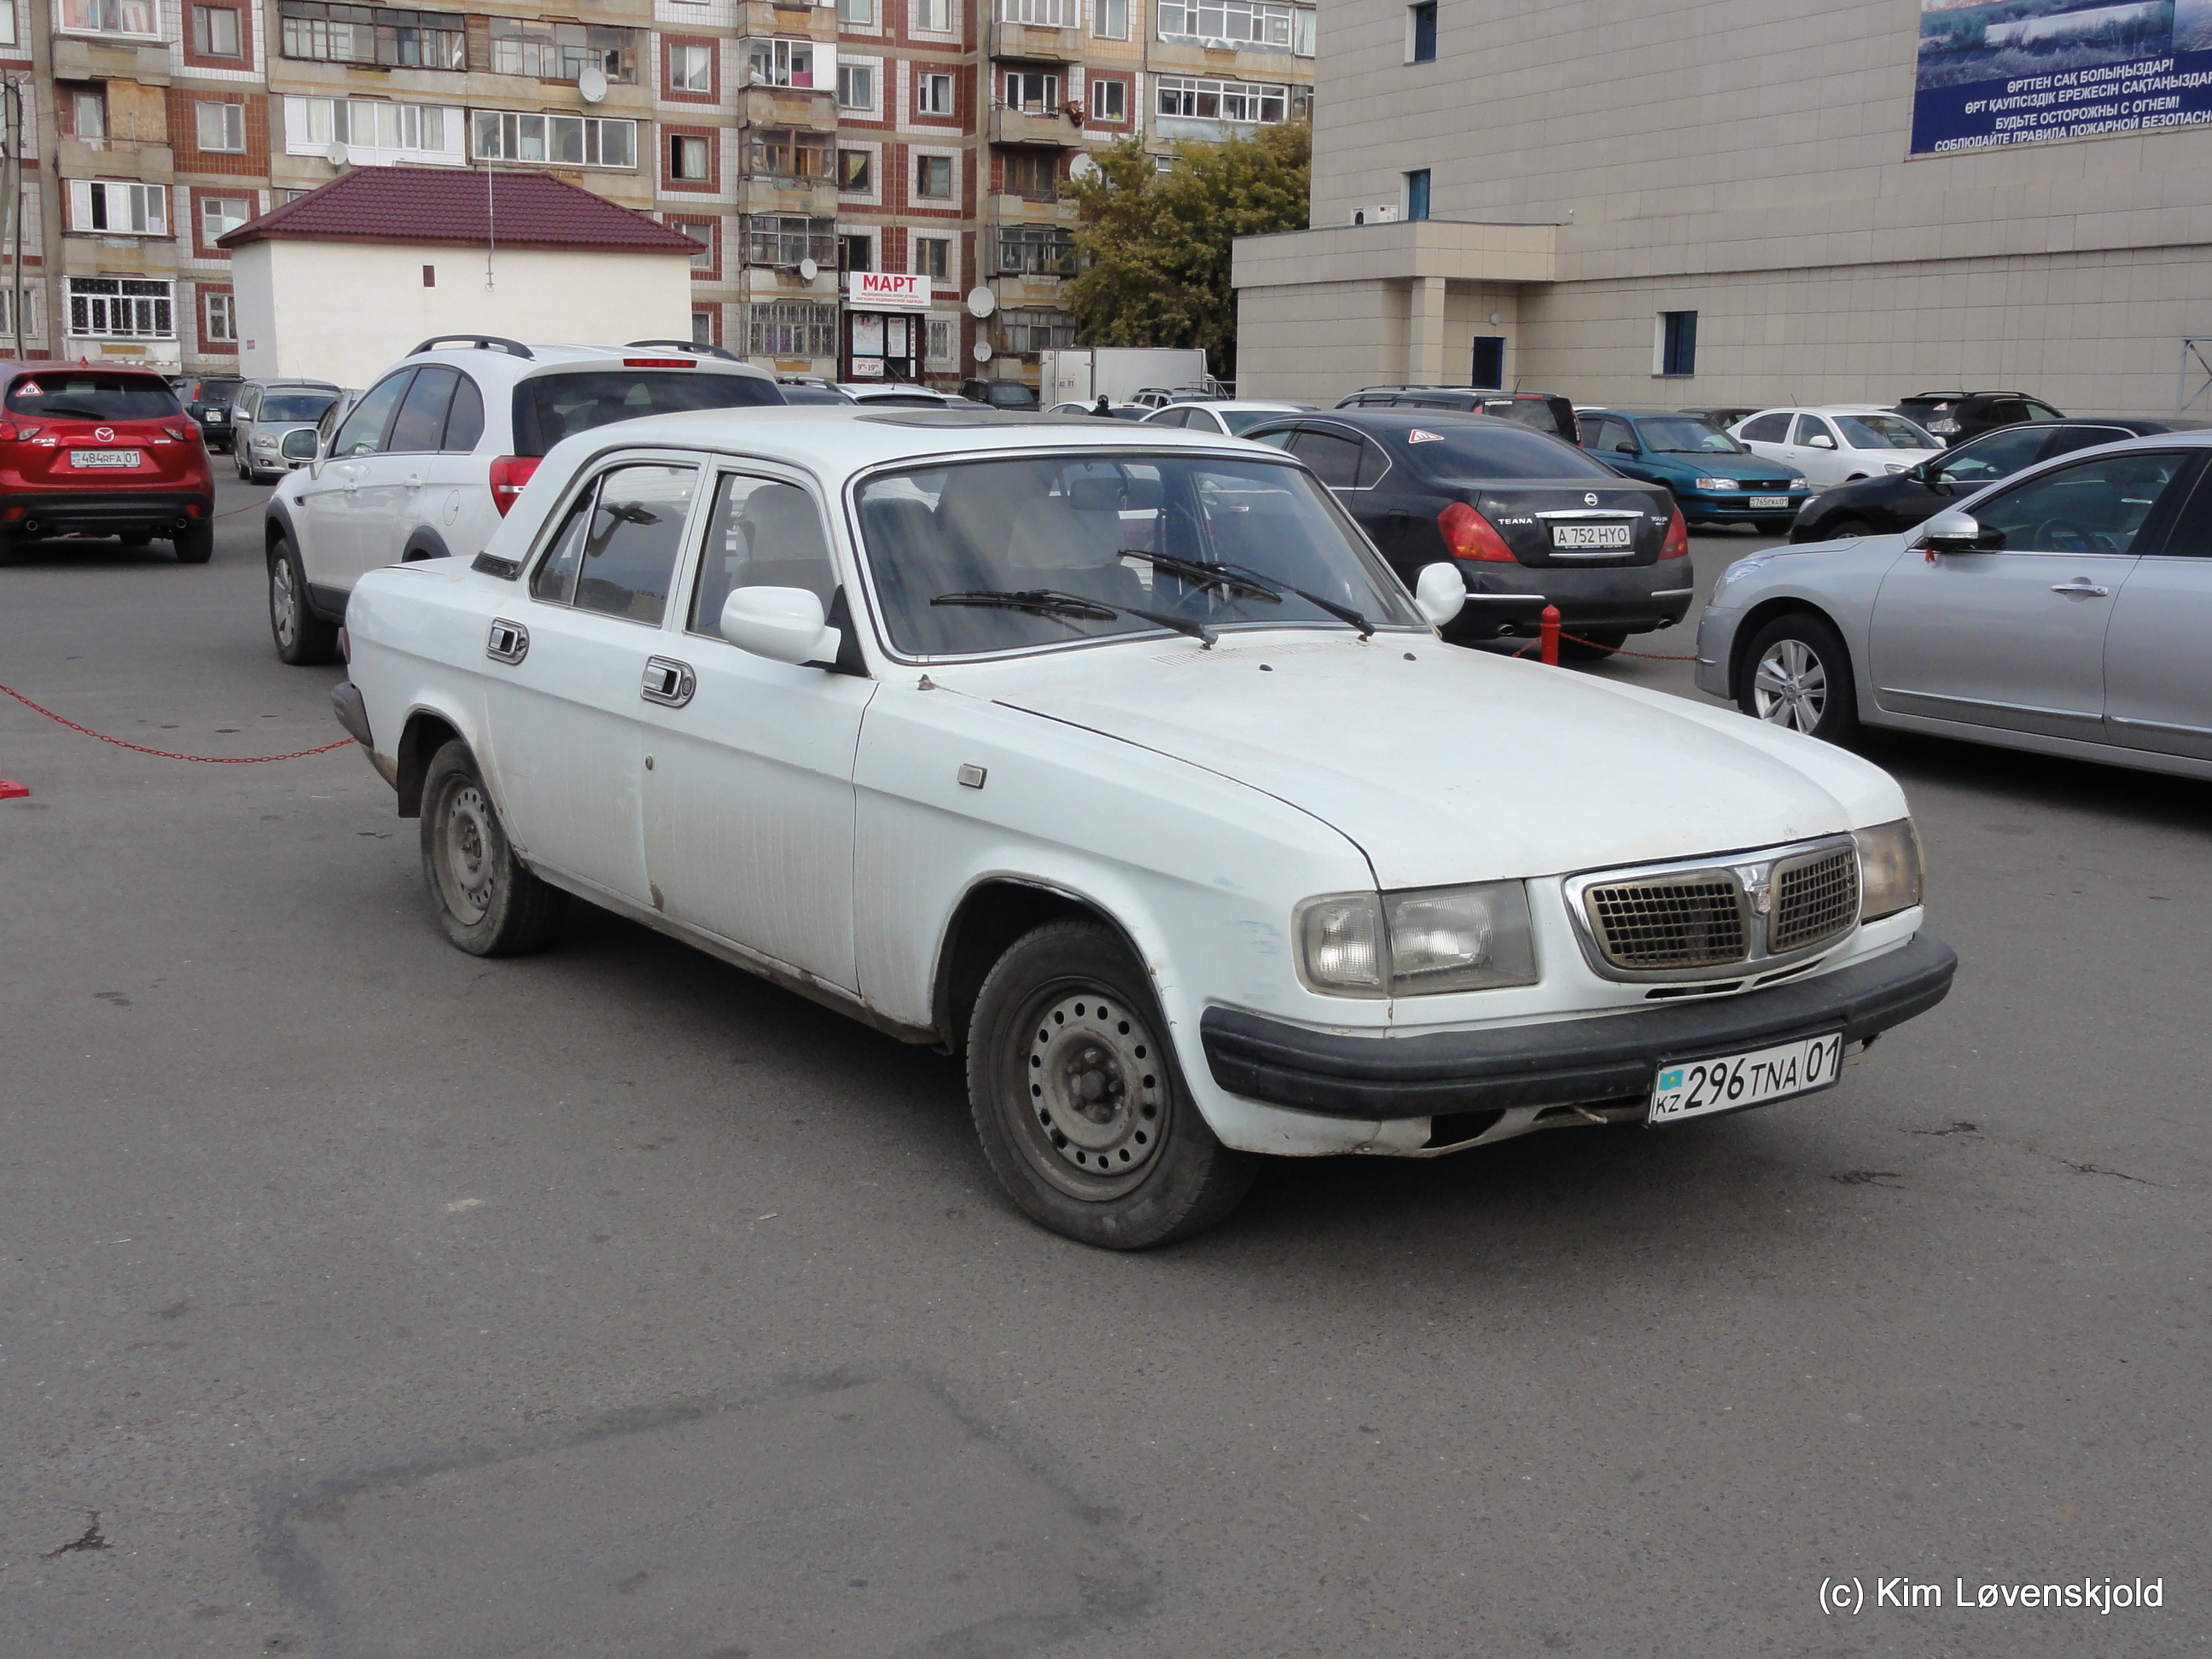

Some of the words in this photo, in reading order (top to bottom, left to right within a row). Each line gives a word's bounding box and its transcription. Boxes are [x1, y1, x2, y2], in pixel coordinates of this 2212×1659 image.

[2007, 78, 2051, 93] ӨРТТЕН
[2054, 72, 2078, 86] САҚ
[2080, 58, 2174, 84] БОЛЫҢЫЗДАР!
[1965, 100, 1988, 114] ӨРТ
[1989, 91, 2056, 113] ҚАУІПСІЗДІК
[2058, 84, 2119, 102] ЕРЕЖЕСІН
[1995, 114, 2037, 131] БУДЬТЕ
[2040, 103, 2118, 125] ОСТОРОЖНЫ
[2121, 102, 2130, 114] С
[2133, 96, 2180, 113] ОГНЕМ!
[1935, 131, 2011, 152] СОБЛЮДАЙТЕ
[2012, 126, 2066, 143] ПРАВИЛА
[2069, 114, 2139, 137] ПОЖАРНОЙ
[2141, 110, 2212, 128] БЕЗОПАСН
[864, 275, 917, 293] МАРТ
[1558, 531, 1567, 544] A
[1573, 529, 1595, 544] 752
[1806, 1036, 1840, 1083] 01
[1656, 1094, 1681, 1115] KZ
